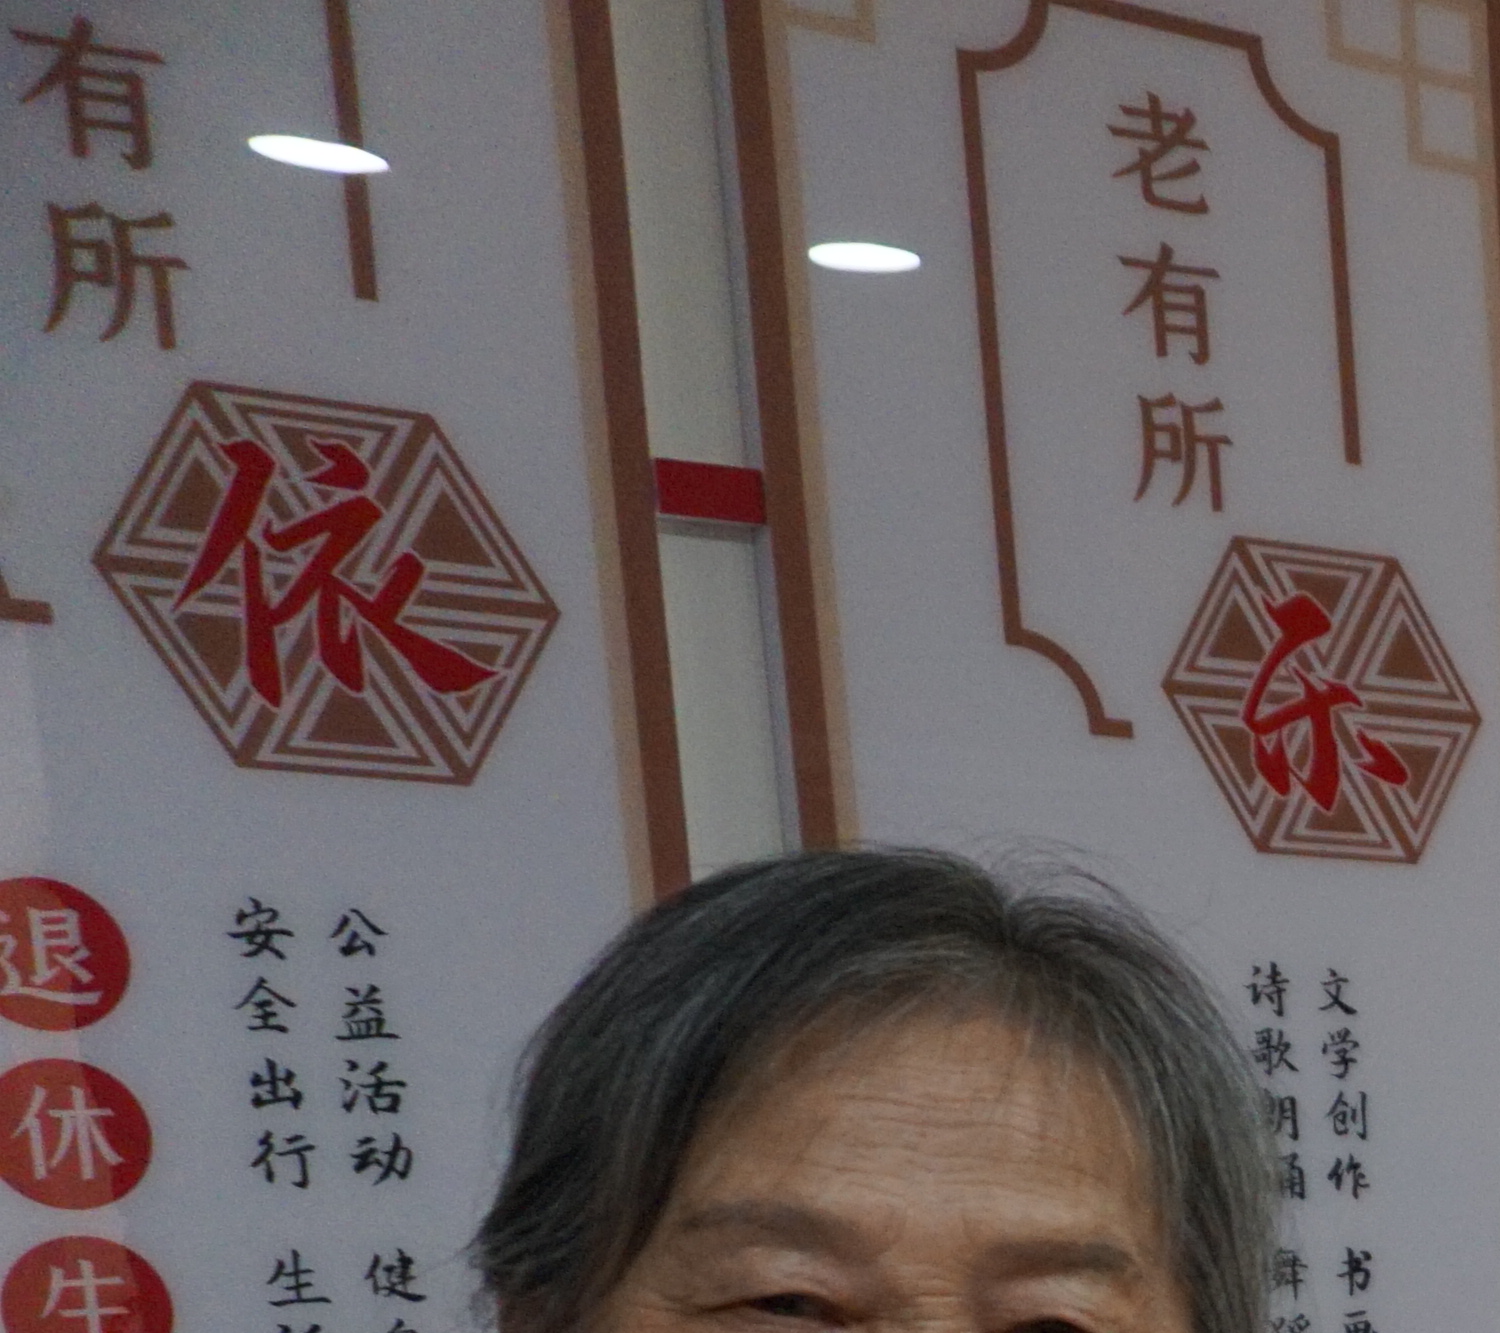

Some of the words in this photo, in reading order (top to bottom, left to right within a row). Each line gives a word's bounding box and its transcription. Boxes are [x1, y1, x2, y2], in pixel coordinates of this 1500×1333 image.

[9, 13, 193, 351] 有所
[1106, 91, 1234, 512] 老有所
[172, 437, 508, 712] 依
[226, 897, 316, 1189] 安全出行
[330, 905, 414, 1187] 公益活动
[1317, 968, 1371, 1200] 文学创作
